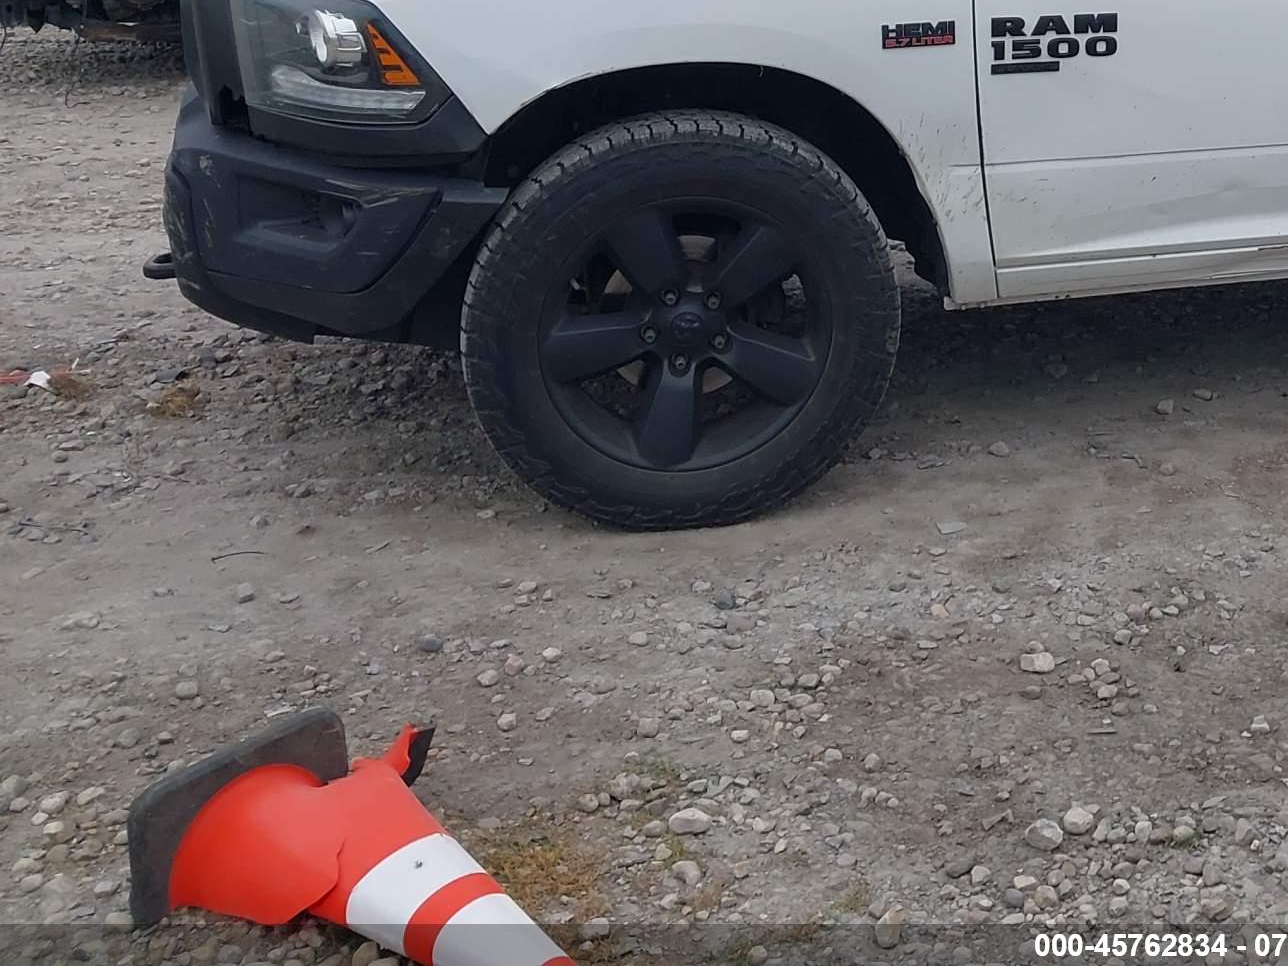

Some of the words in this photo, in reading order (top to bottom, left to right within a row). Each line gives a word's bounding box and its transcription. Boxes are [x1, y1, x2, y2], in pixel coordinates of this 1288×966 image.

[881, 20, 956, 38] HEMI
[990, 13, 1118, 38] RAM
[885, 37, 911, 48] 5.7
[911, 35, 954, 46] LITER
[990, 36, 1118, 61] 1500
